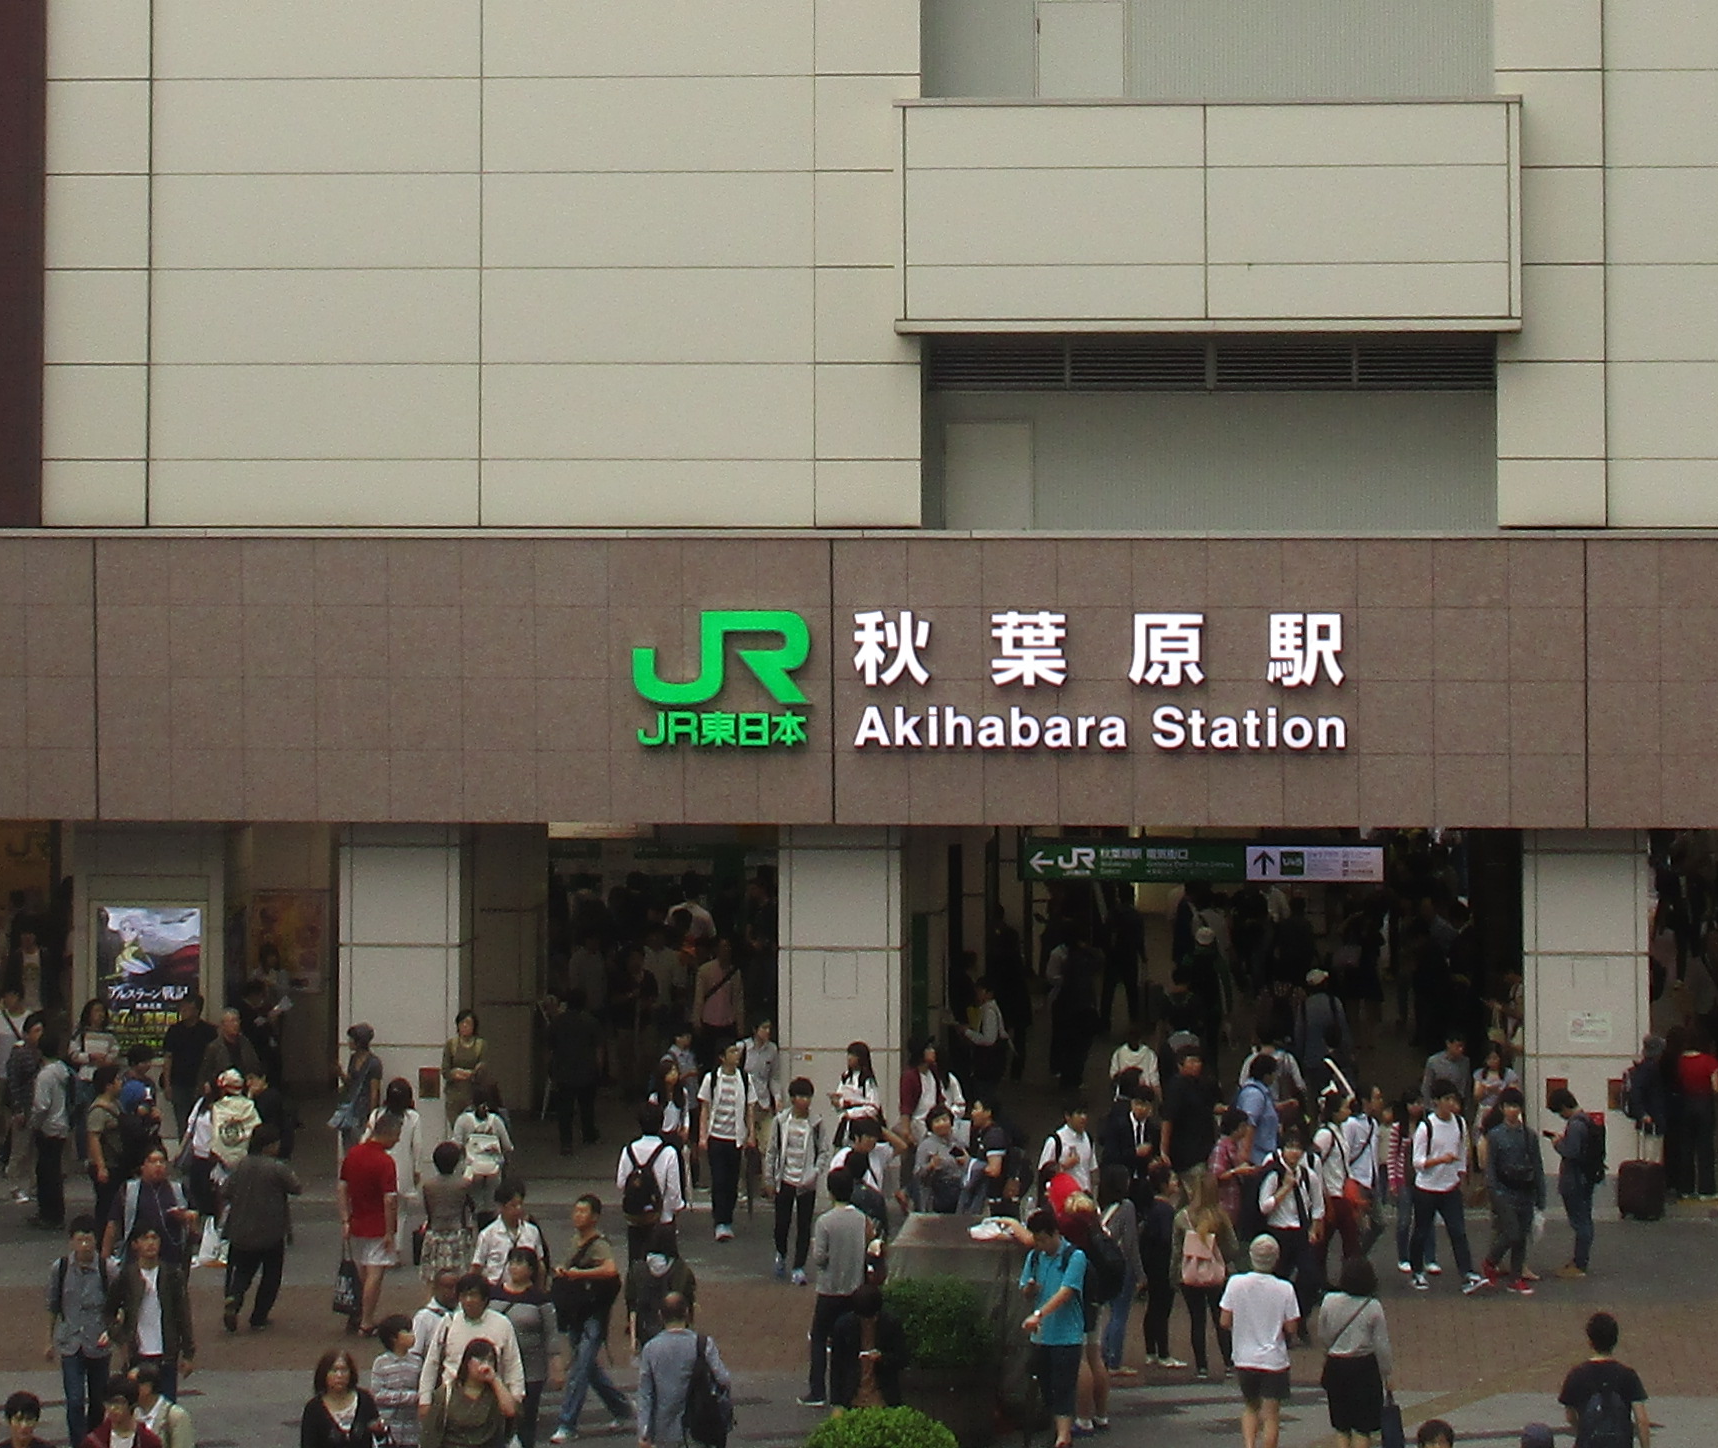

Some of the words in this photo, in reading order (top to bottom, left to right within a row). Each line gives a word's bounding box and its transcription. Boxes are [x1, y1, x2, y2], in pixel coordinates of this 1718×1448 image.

[632, 610, 812, 705] JR
[853, 610, 1346, 687] 秋葉原駅
[636, 711, 807, 747] JR東日本
[855, 706, 1127, 749] Akihabara
[1151, 705, 1348, 749] Station
[1058, 847, 1096, 870] JR
